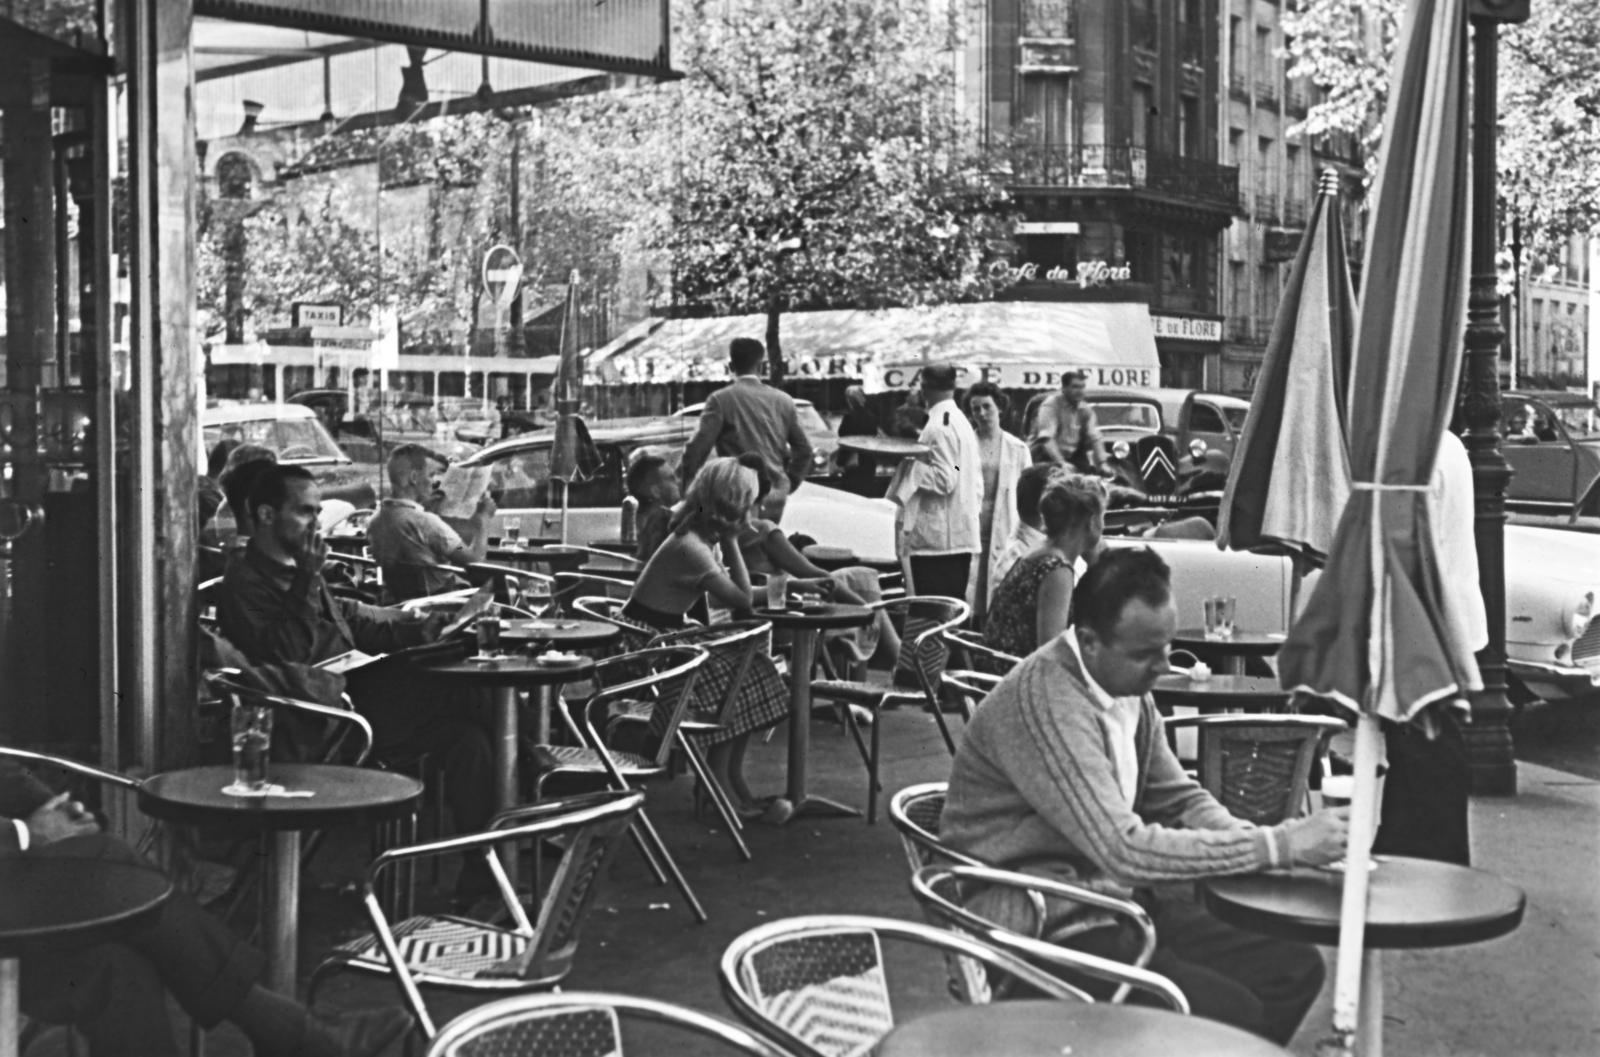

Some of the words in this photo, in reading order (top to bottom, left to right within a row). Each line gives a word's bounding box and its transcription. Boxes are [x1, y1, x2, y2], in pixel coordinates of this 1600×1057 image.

[1046, 265, 1068, 280] de
[305, 310, 336, 320] TAXIS
[1182, 319, 1217, 337] FLORE
[1022, 370, 1061, 386] DE
[1078, 367, 1151, 387] FLORE
